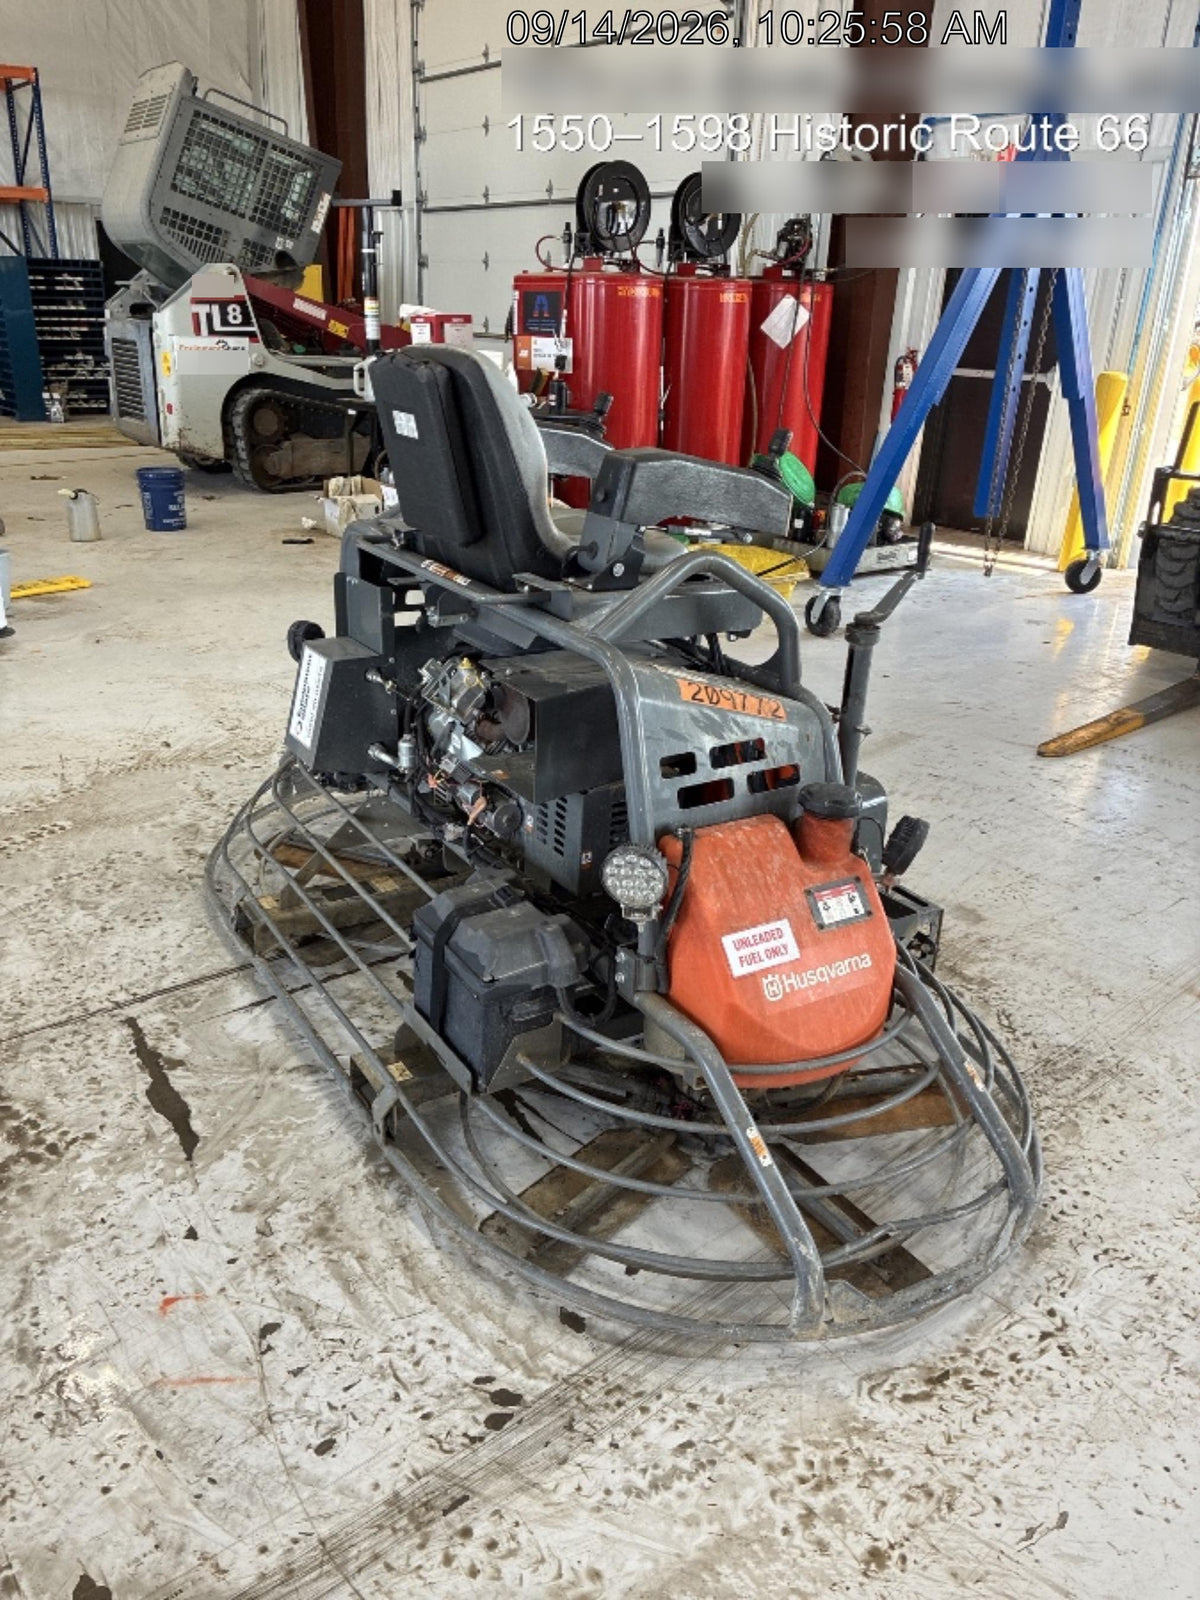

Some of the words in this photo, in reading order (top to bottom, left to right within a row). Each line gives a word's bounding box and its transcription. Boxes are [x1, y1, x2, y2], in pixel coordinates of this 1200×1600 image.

[731, 927, 784, 952] UNLEADED
[738, 948, 765, 968] FUEL
[765, 943, 789, 961] ONLY
[783, 953, 873, 993] Husqvarna
